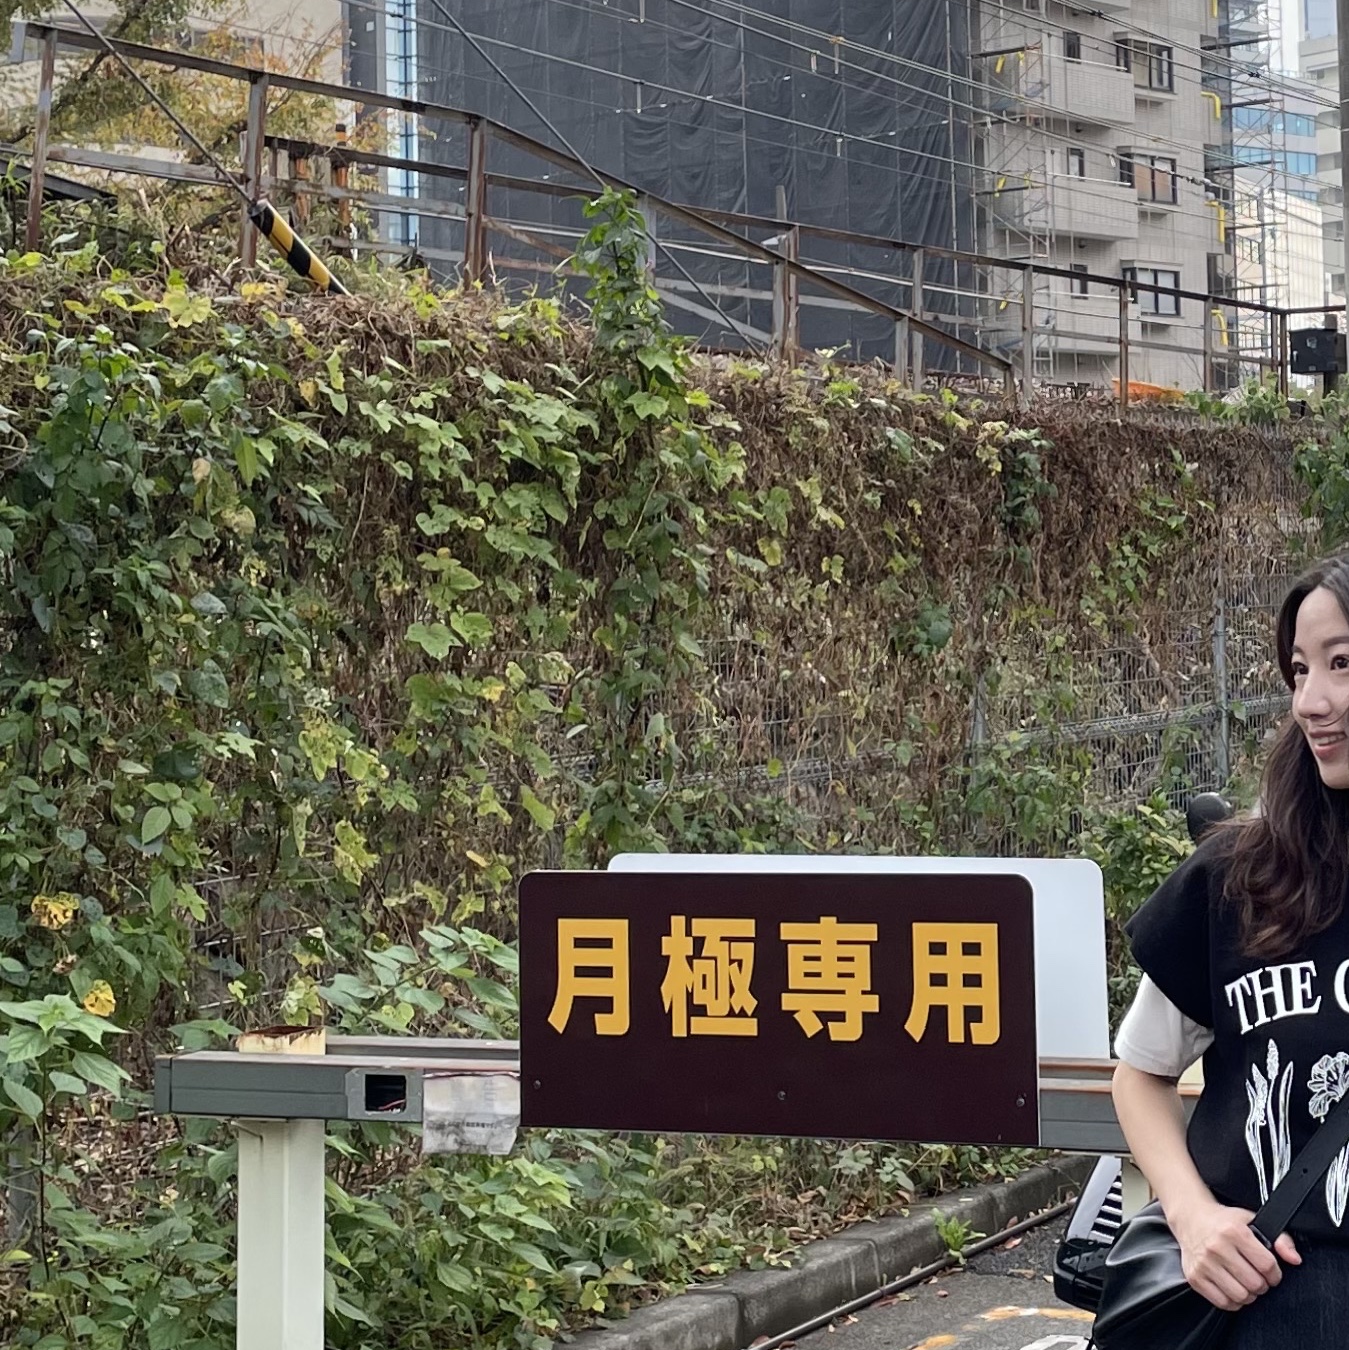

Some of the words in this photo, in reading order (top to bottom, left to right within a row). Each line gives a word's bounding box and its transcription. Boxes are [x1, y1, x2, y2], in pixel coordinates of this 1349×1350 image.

[547, 915, 1000, 1045] 月極専用
[1225, 960, 1321, 1034] THE
